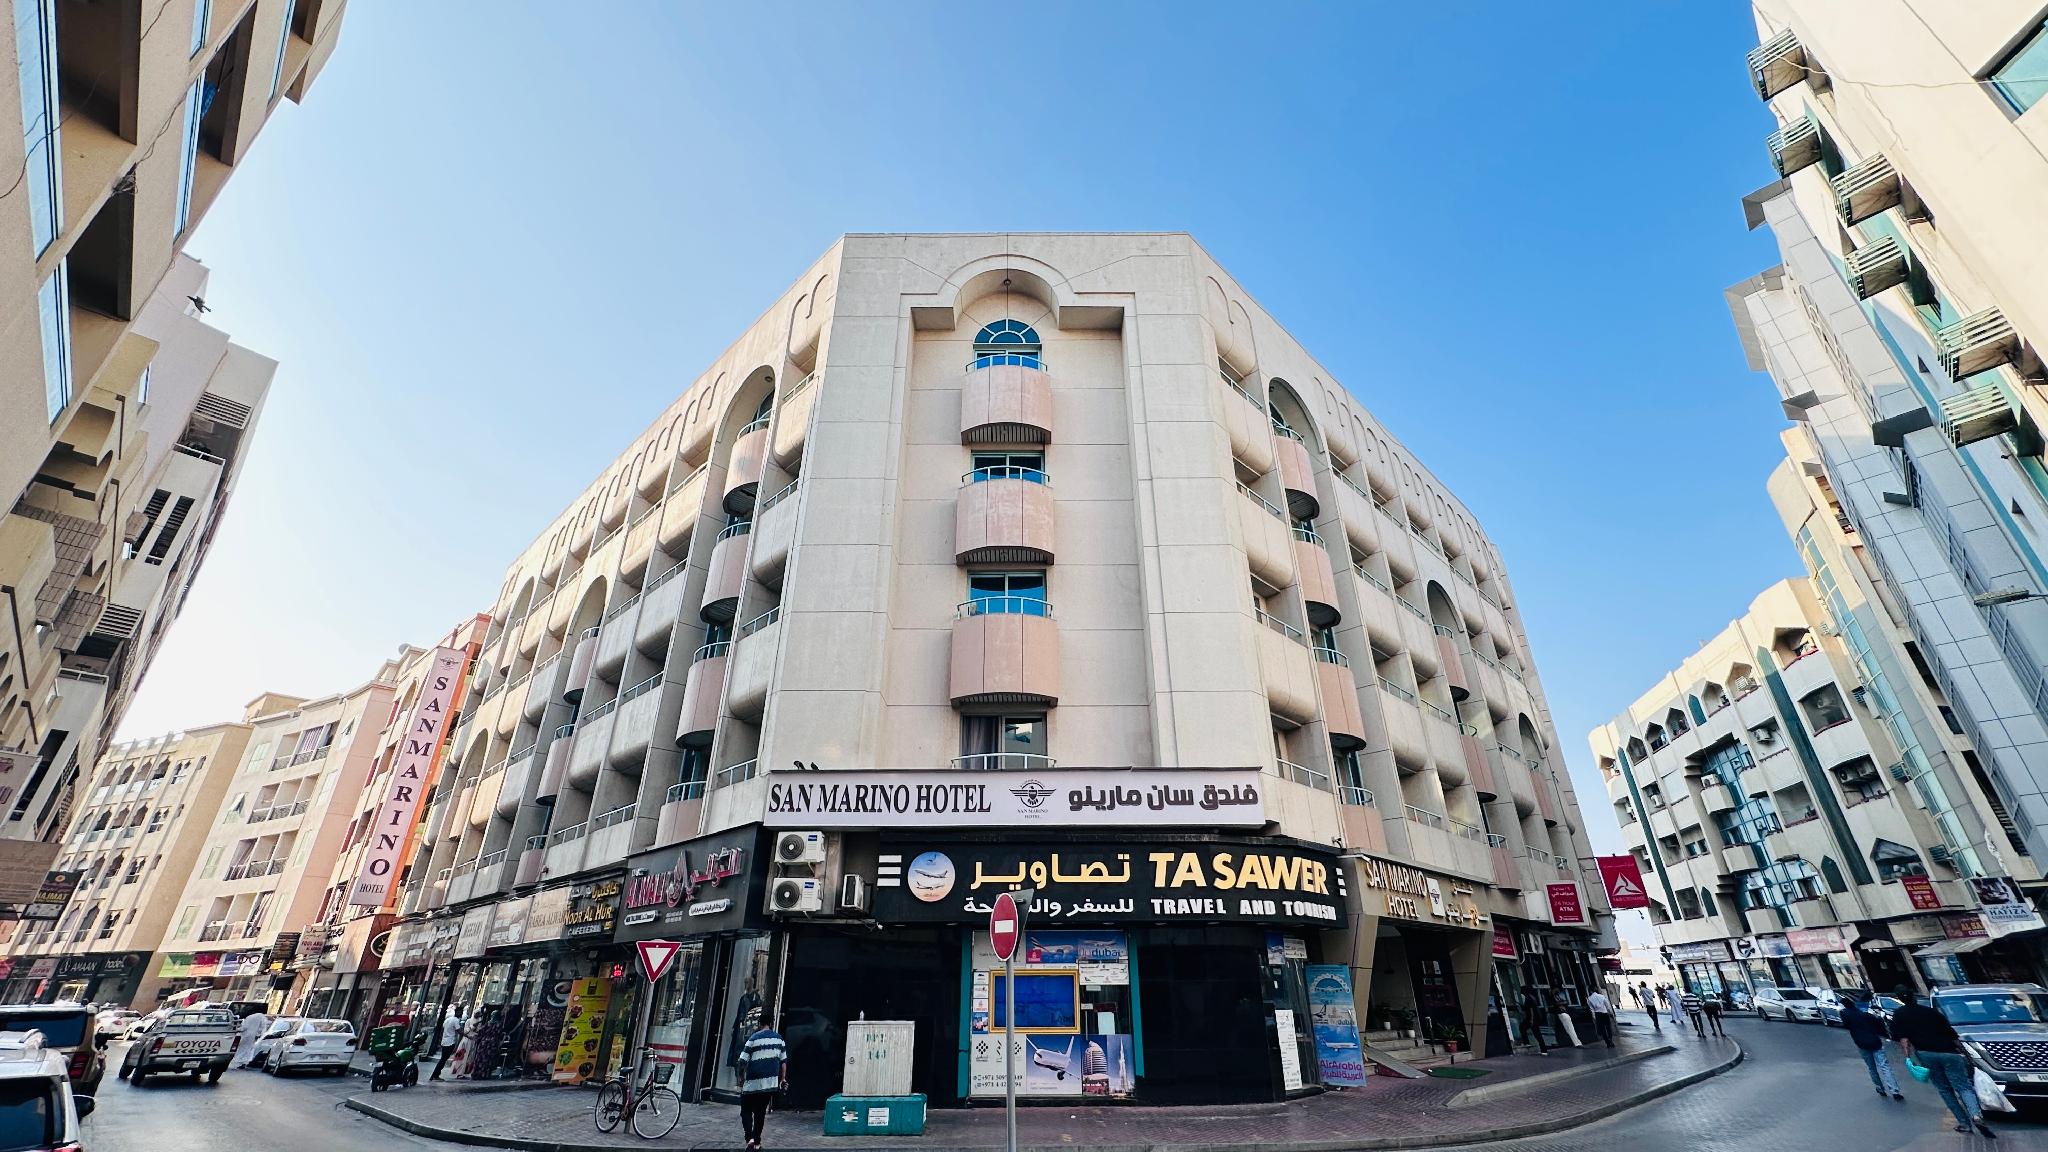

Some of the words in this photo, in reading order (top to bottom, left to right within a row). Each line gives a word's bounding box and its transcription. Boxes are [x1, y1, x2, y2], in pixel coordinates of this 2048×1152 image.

[768, 783, 814, 813] SAN
[816, 784, 910, 813] MARINO
[914, 784, 992, 813] HOTEL
[1068, 785, 1143, 812] مارينو
[1147, 784, 1195, 811] سان
[1199, 784, 1259, 811] فندق
[970, 853, 1131, 891] تصاوير
[358, 883, 385, 894] HOTEL
[1066, 898, 1135, 917] للسفر
[1151, 898, 1227, 915] TRAVEL
[1239, 900, 1276, 915] AND
[1282, 900, 1337, 921] TOURISM
[174, 1040, 222, 1049] TOYOTA
